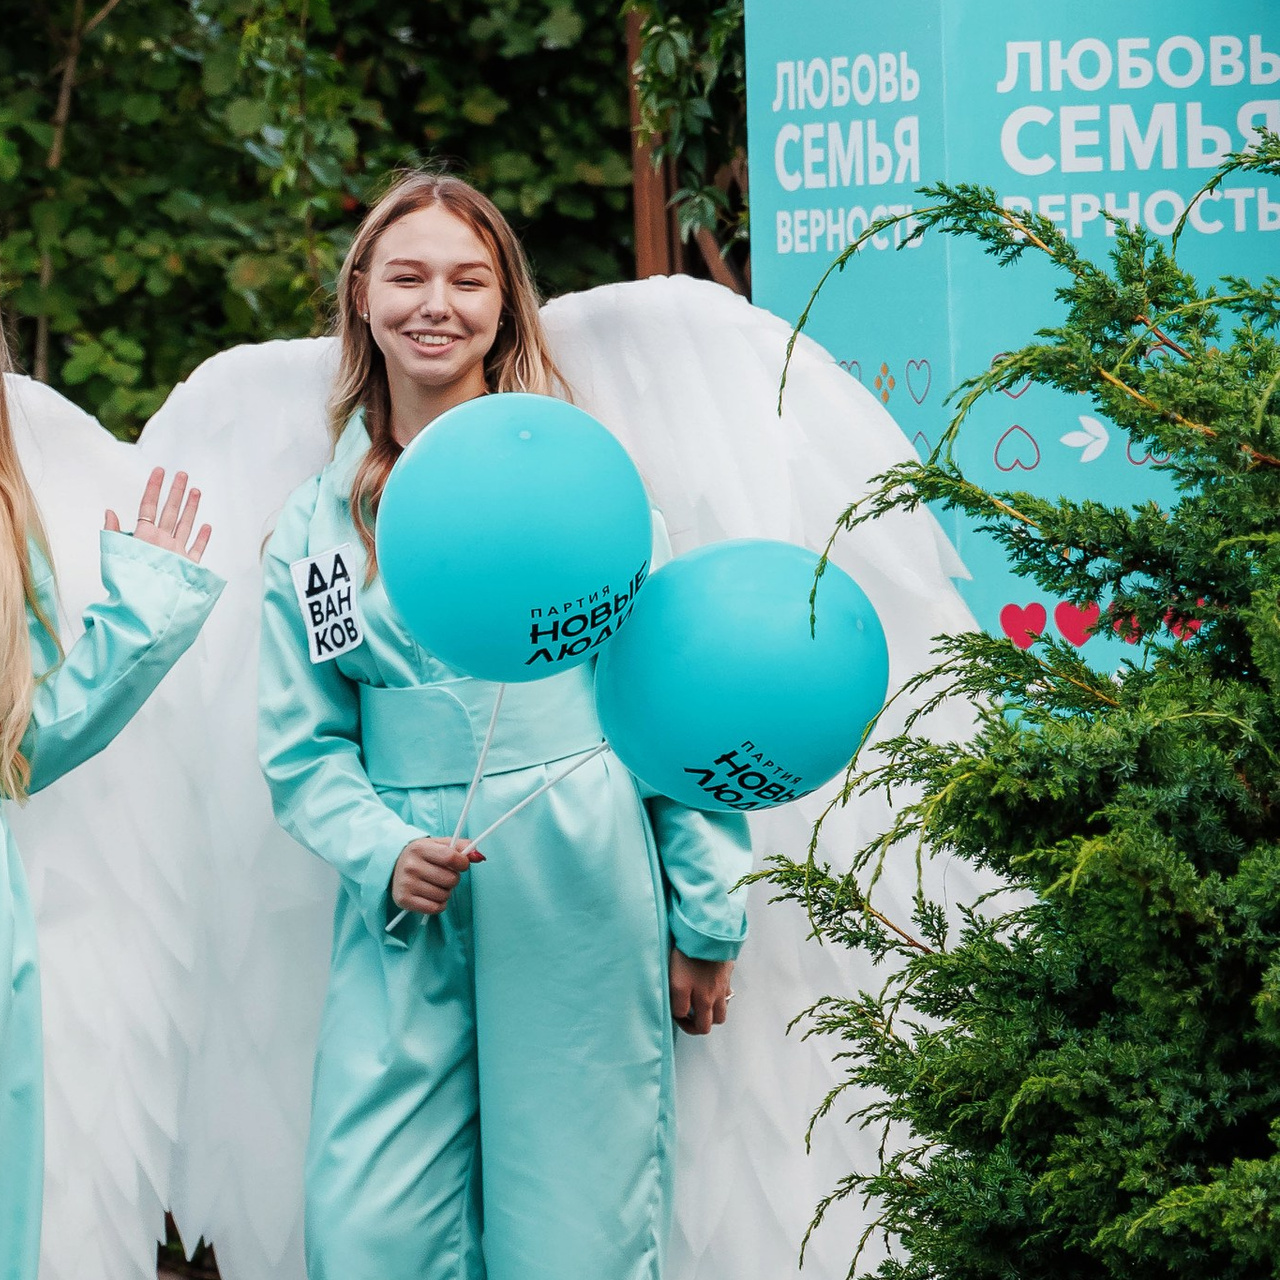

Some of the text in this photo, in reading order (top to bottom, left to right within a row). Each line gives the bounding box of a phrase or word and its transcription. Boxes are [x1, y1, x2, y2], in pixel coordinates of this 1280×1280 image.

[772, 51, 921, 112] ЛЮБОВЬ
[996, 35, 1280, 94] ЛЮБОВЬ
[774, 115, 921, 192] СЕМЬЯ
[305, 553, 351, 598] ДА
[307, 586, 352, 628] ВАН
[529, 559, 648, 645] НОВЫЕ
[530, 584, 611, 619] ПАРТИЯ
[314, 616, 359, 656] КОВ
[741, 740, 803, 785] ПАРТИЯ
